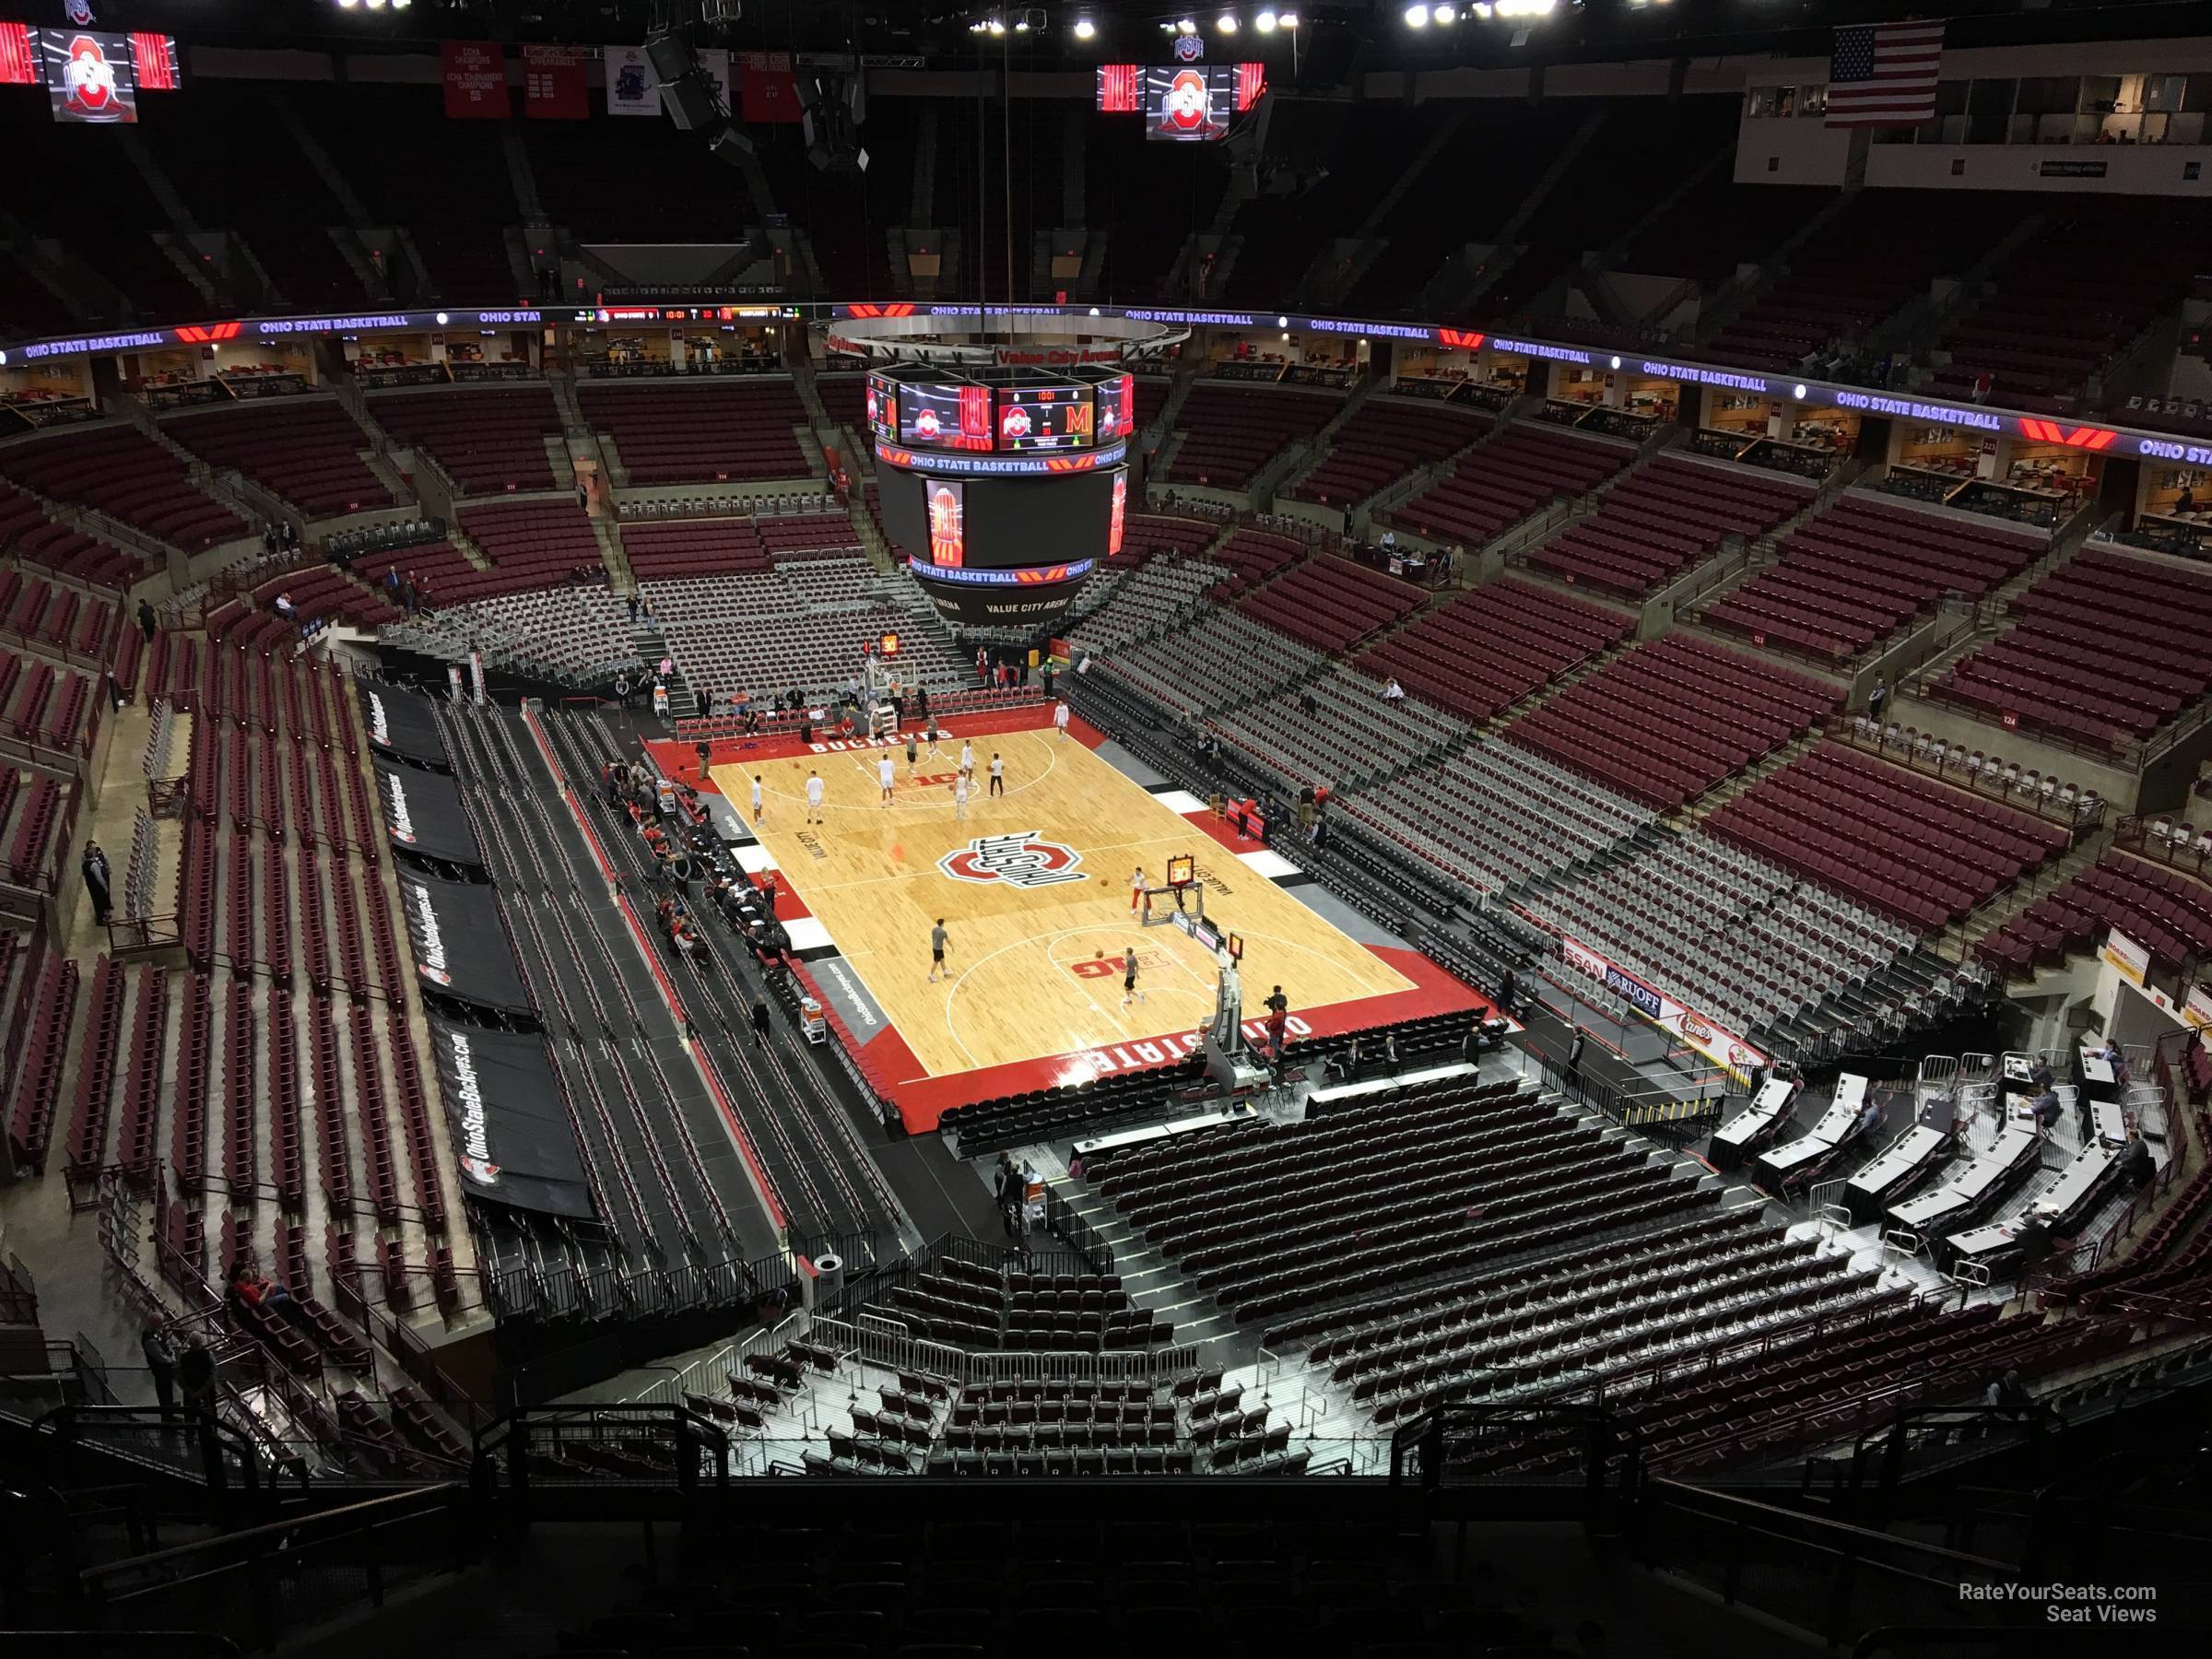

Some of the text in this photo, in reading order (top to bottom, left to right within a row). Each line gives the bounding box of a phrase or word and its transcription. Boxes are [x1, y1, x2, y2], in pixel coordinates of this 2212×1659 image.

[259, 316, 408, 333] OHIO STATE BASKETBALL
[479, 312, 511, 322] OHIO
[1125, 310, 1253, 325] OHIO STATE BASKETBALL
[1311, 320, 1429, 339] OHIO STATE BASKETBALL
[25, 332, 163, 358] OHIO STATE BASKETBALL
[1494, 339, 1590, 364] OHIO STATE BASKETBALL
[1643, 362, 1766, 391] OHIO STATE BASKETBALL
[1066, 406, 1089, 433] M
[1836, 392, 2000, 430] OHIO STATE BASKETBALL
[1095, 453, 1112, 465] OHIO
[2139, 440, 2184, 459] OHIO
[910, 456, 1048, 472] OHIO STATE BASKETBALL
[923, 565, 945, 577] STATE
[948, 570, 1018, 582] BASKETBALL
[1066, 564, 1083, 576] OHIO
[987, 604, 1018, 613] VALUE
[1021, 603, 1044, 612] CITY
[1202, 877, 1234, 896] VALUE
[414, 885, 445, 969] OhioStateBuckeyes.com
[828, 963, 877, 1026] OhioStateBuckeyes.com
[1620, 978, 1660, 1008] RUOFF
[1088, 1016, 1312, 1072] OI STATE
[451, 1033, 490, 1159] OhioStateBuckeyes.com
